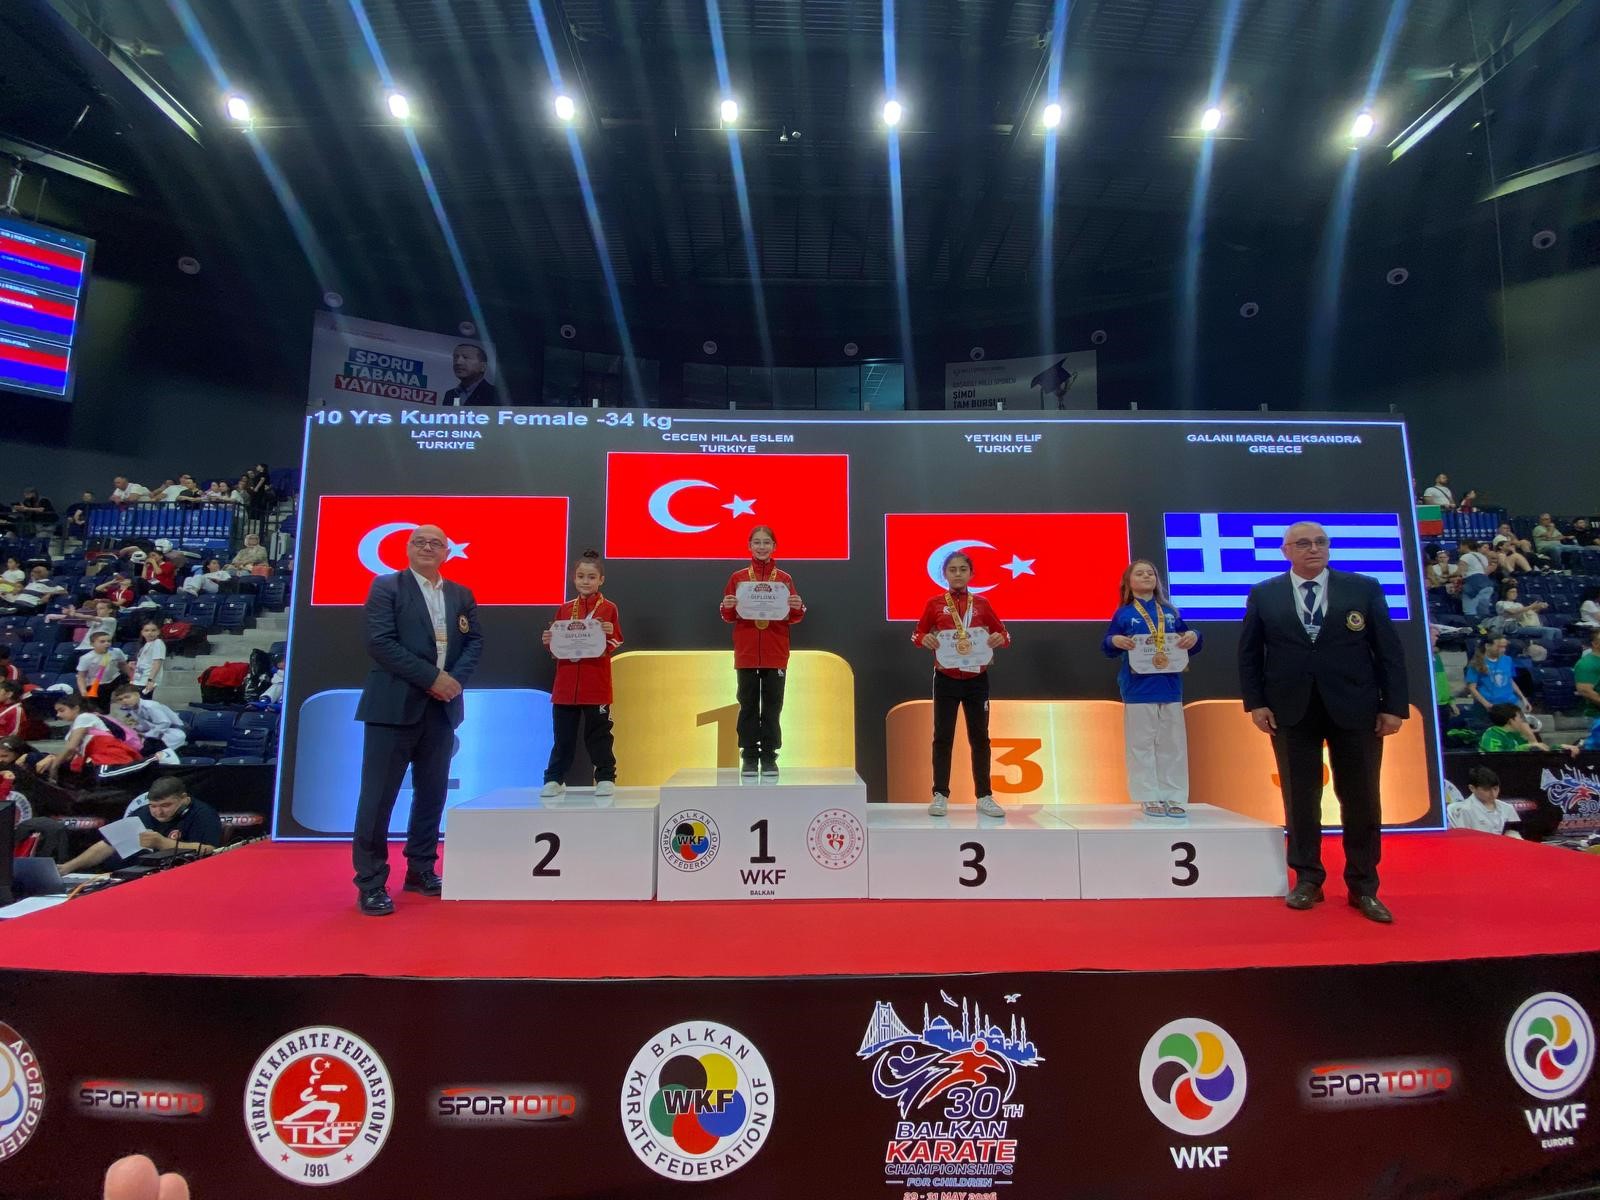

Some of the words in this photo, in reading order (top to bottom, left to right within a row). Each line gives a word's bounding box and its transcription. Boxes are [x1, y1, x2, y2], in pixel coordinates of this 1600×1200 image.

[355, 351, 414, 372] SPORU
[350, 365, 420, 387] TABANA
[337, 376, 435, 404] YAYIYORUZ
[314, 410, 342, 425] 10
[350, 410, 392, 425] Yrs
[401, 410, 490, 425] Kumite
[498, 411, 588, 426] Female
[596, 412, 635, 427] -34
[643, 413, 672, 430] kg
[411, 430, 448, 438] LAFCI
[451, 430, 481, 438] SINA
[662, 433, 707, 441] CECEN
[711, 434, 747, 442] HILAL
[750, 434, 794, 442] ESLEM
[964, 434, 1012, 442] YETKIN
[1015, 434, 1042, 442] ELIF
[1187, 434, 1234, 442] GALANI
[1236, 434, 1275, 442] MARIA
[1277, 434, 1362, 443] ALEKSANDRA
[417, 441, 475, 449] TURKIYE
[700, 444, 756, 452] TURKIYE
[975, 445, 1032, 453] TURKIYE
[1249, 445, 1303, 453] GREECE
[990, 738, 1044, 795] 3
[672, 812, 711, 826] BALKAN
[677, 835, 706, 845] WKF
[710, 831, 718, 843] OF
[749, 819, 776, 864] 1
[532, 832, 561, 877] 2
[663, 828, 675, 861] KARATE
[673, 844, 718, 870] FEDERATION
[958, 841, 988, 887] 3
[1170, 841, 1199, 887] 3
[740, 869, 786, 885] WKF
[651, 1028, 749, 1060] BALKAN
[251, 1069, 273, 1143] TÜRKİYE
[267, 1033, 329, 1071] KARATE
[334, 1036, 386, 1145] FEDERASYONU
[752, 1078, 769, 1105] OF
[662, 1089, 735, 1115] WKF
[627, 1070, 656, 1156] KARATE
[1525, 1103, 1587, 1134] WKF
[283, 1126, 356, 1144] TKF
[895, 1121, 1007, 1139] BALKAN
[654, 1112, 768, 1176] FEDERATION
[885, 1140, 1018, 1163] KARATE
[1541, 1136, 1574, 1149] EUROPE
[1169, 1146, 1229, 1169] WKF
[303, 1163, 330, 1177] 1981
[885, 1163, 1014, 1175] CHAMPIONSHIPS
[906, 1178, 932, 1187] FOR
[932, 1178, 992, 1188] CHILDREN
[941, 1192, 967, 1200] MAY
